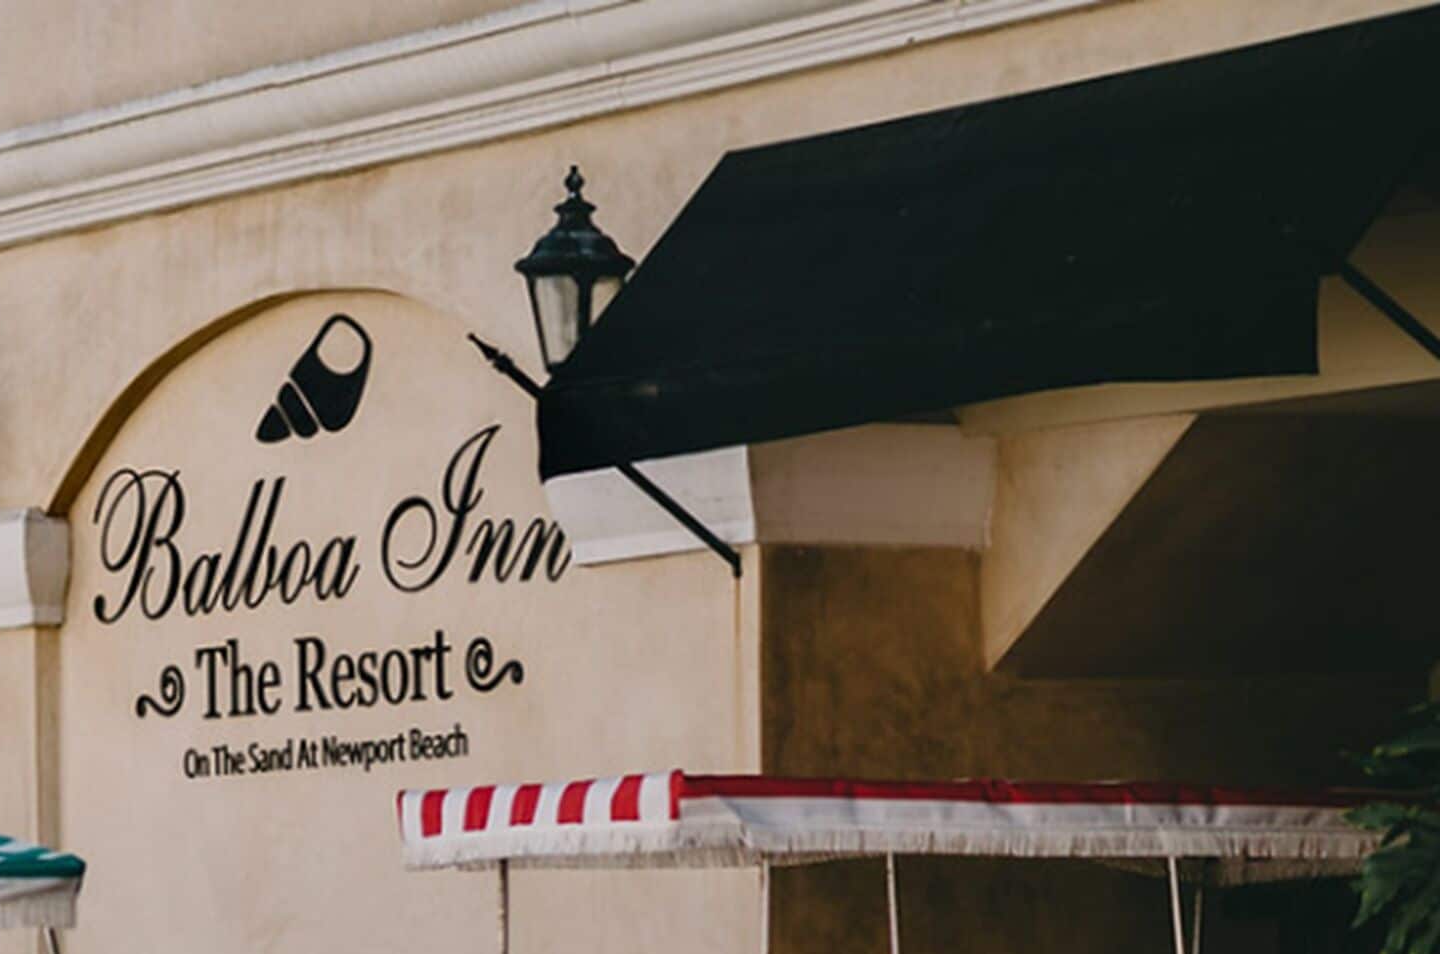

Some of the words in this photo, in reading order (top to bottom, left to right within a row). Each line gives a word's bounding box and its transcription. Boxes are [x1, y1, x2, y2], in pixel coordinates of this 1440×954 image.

[93, 468, 361, 624] Balboa
[381, 424, 573, 593] Inn
[195, 639, 282, 719] The
[293, 630, 454, 713] Resort
[183, 749, 211, 778] On
[211, 745, 246, 775] The
[247, 739, 294, 773] Sand
[296, 739, 319, 769] At
[321, 734, 406, 772] Newport
[409, 724, 469, 760] Beach
